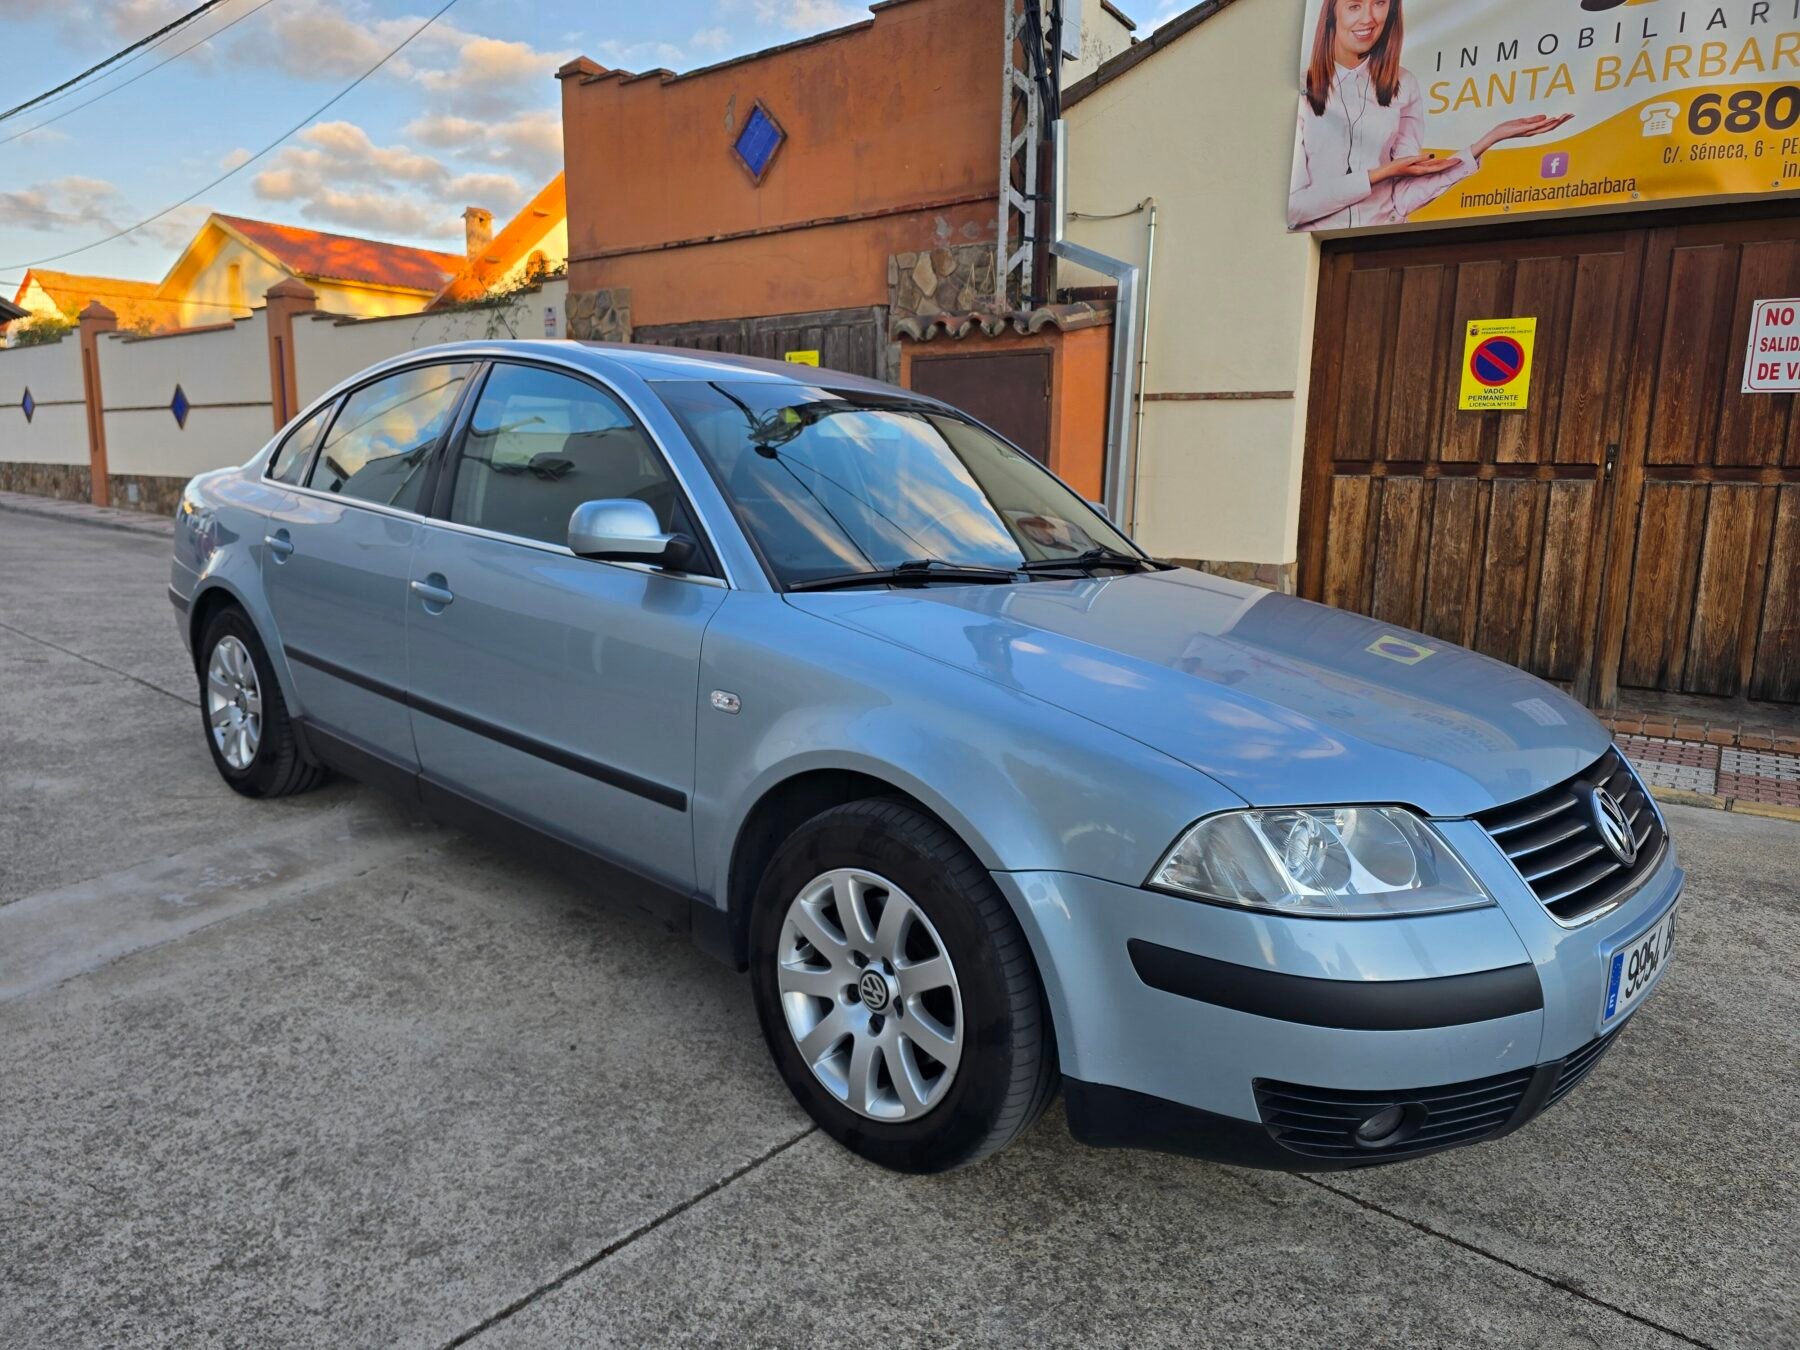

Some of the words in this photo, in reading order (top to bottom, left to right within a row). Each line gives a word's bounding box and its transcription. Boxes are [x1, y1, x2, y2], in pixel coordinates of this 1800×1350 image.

[1428, 62, 1576, 115] SANTA
[1688, 85, 1800, 136] 680
[1689, 142, 1748, 161] Séneca,
[1754, 140, 1764, 158] 6
[1781, 137, 1800, 155] PE
[1782, 160, 1800, 179] in
[1460, 177, 1636, 208] inmobiliariasantabarbara
[1765, 307, 1795, 326] NO
[1760, 336, 1800, 353] SALID
[1757, 362, 1781, 380] DE
[1786, 362, 1800, 380] V
